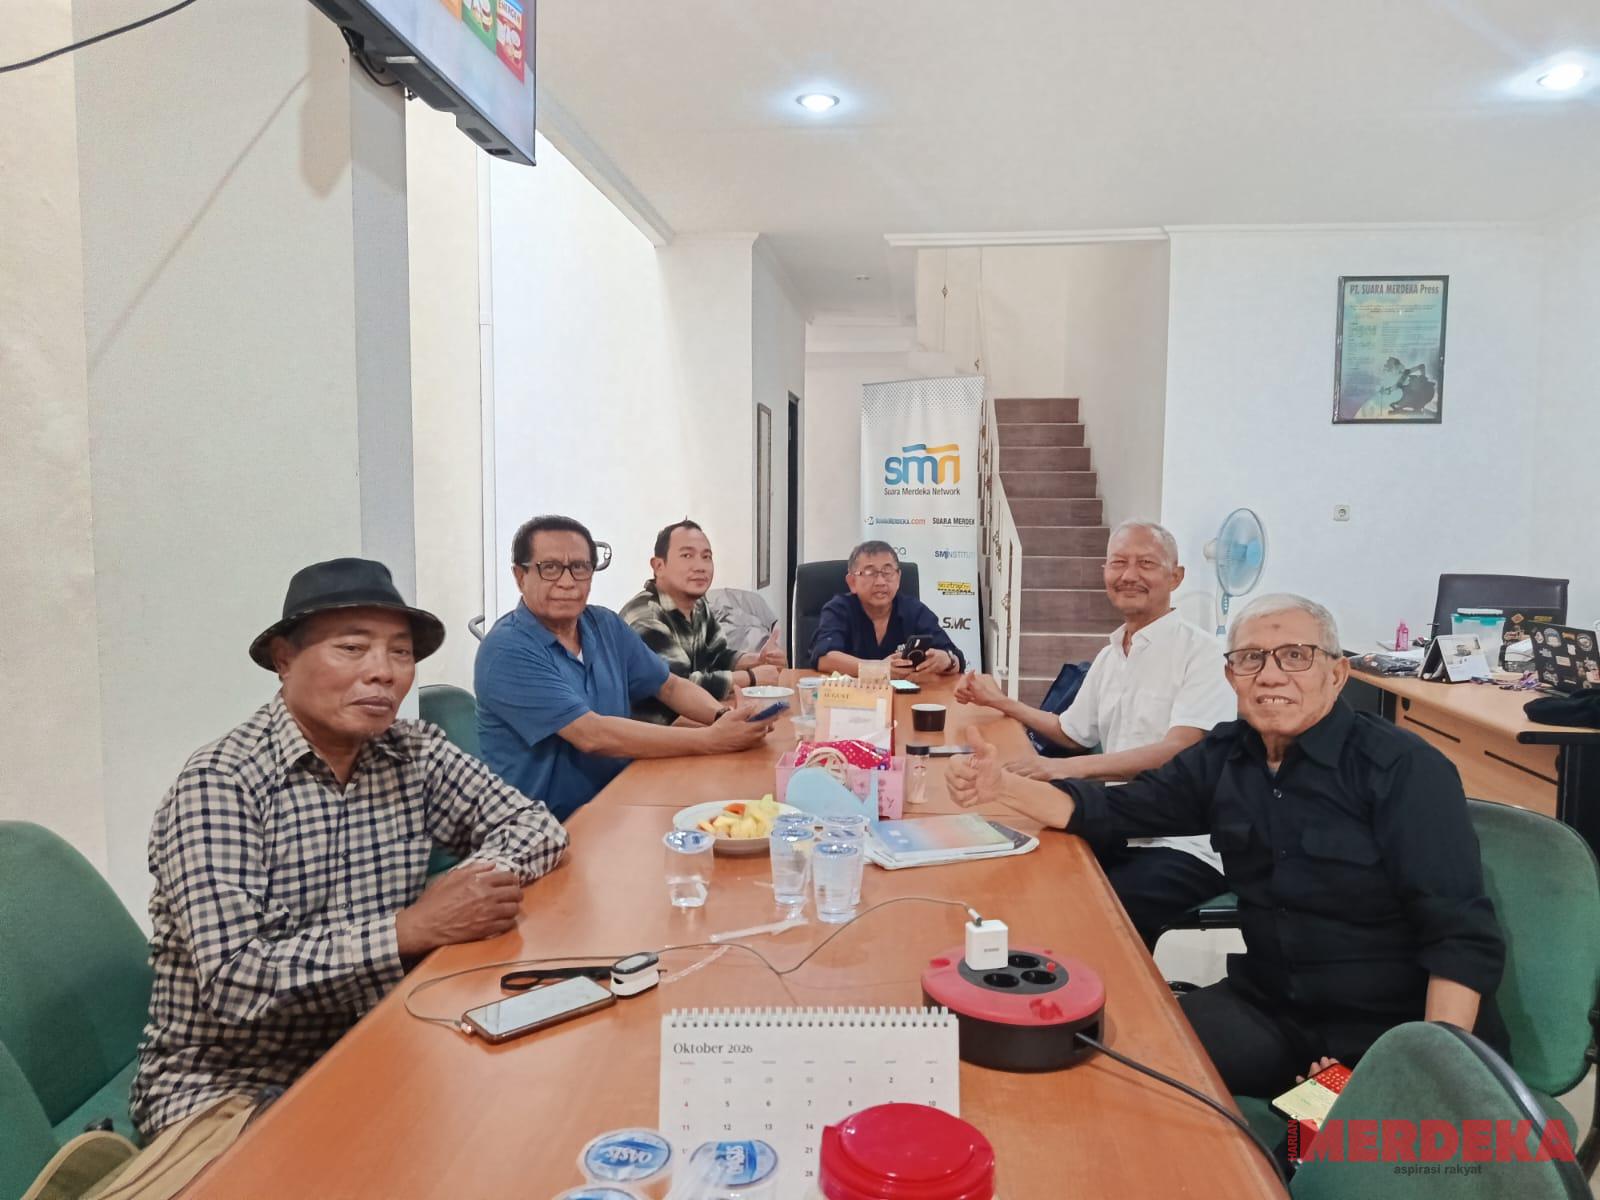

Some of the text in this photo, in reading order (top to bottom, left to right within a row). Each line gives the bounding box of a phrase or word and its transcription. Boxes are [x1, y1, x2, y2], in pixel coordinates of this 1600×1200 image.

[1362, 284, 1383, 294] SUARA
[1386, 284, 1418, 294] MERDEKA
[1420, 284, 1439, 294] Press
[884, 487, 960, 496] Suara Merdeka Network
[932, 517, 951, 525] SUARA
[673, 1042, 753, 1054] Oktober 2026
